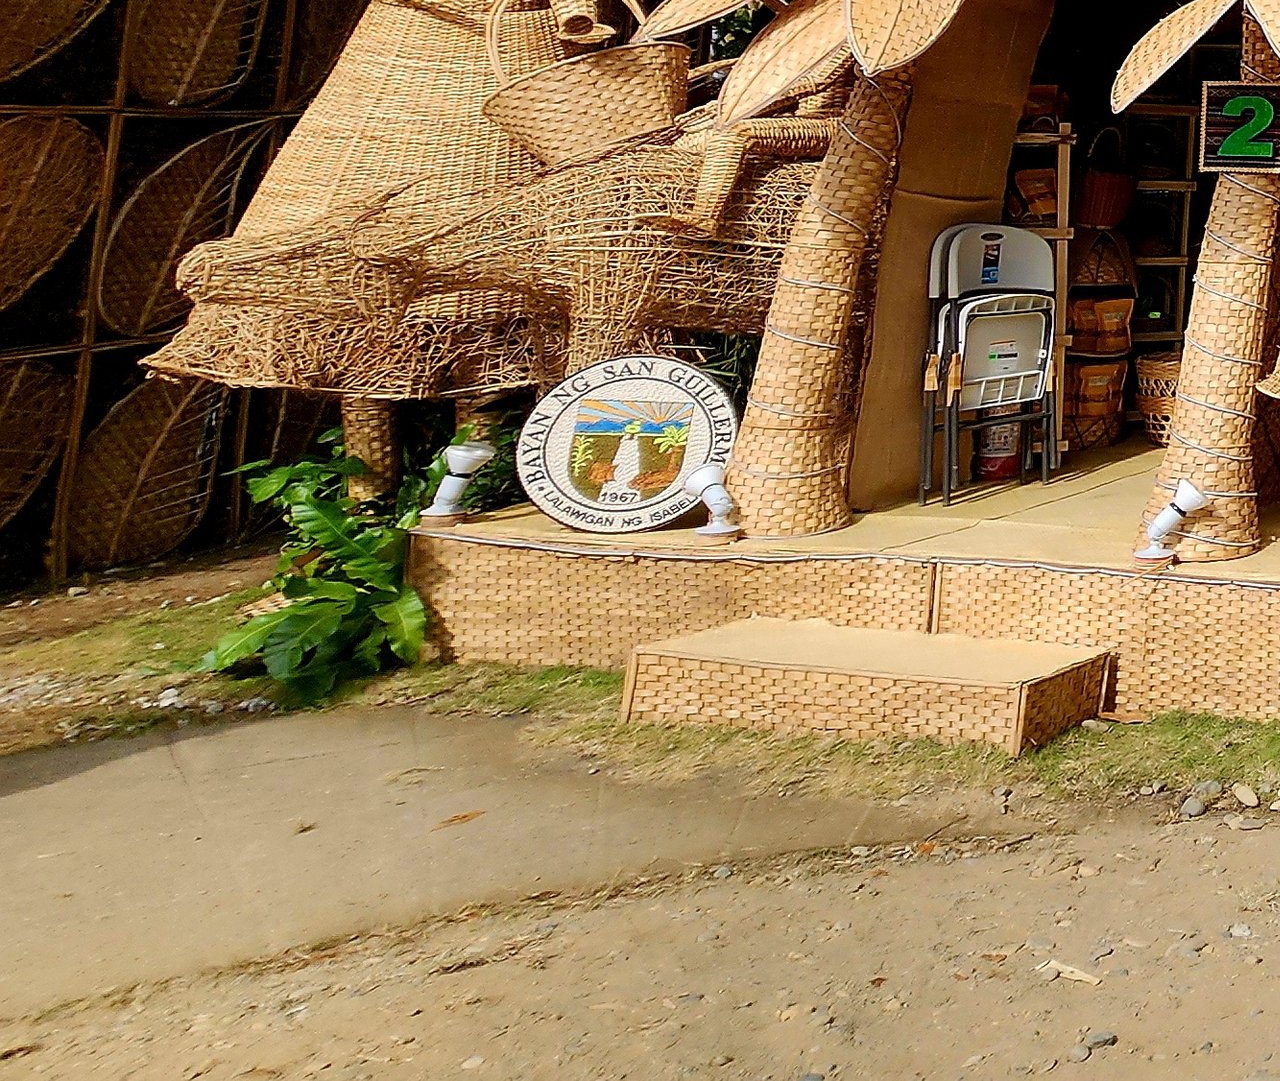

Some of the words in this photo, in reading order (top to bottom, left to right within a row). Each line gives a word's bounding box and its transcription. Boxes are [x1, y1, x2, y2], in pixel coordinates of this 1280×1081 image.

[1217, 95, 1274, 158] 2
[521, 411, 551, 485] BAYAN
[551, 376, 590, 406] NG
[603, 361, 656, 380] SAN
[668, 367, 733, 464] GUILLERM
[543, 490, 615, 527] LALAWIGAN
[621, 516, 643, 529] NG
[650, 495, 699, 523] ISABEL
[601, 492, 638, 503] 1967
